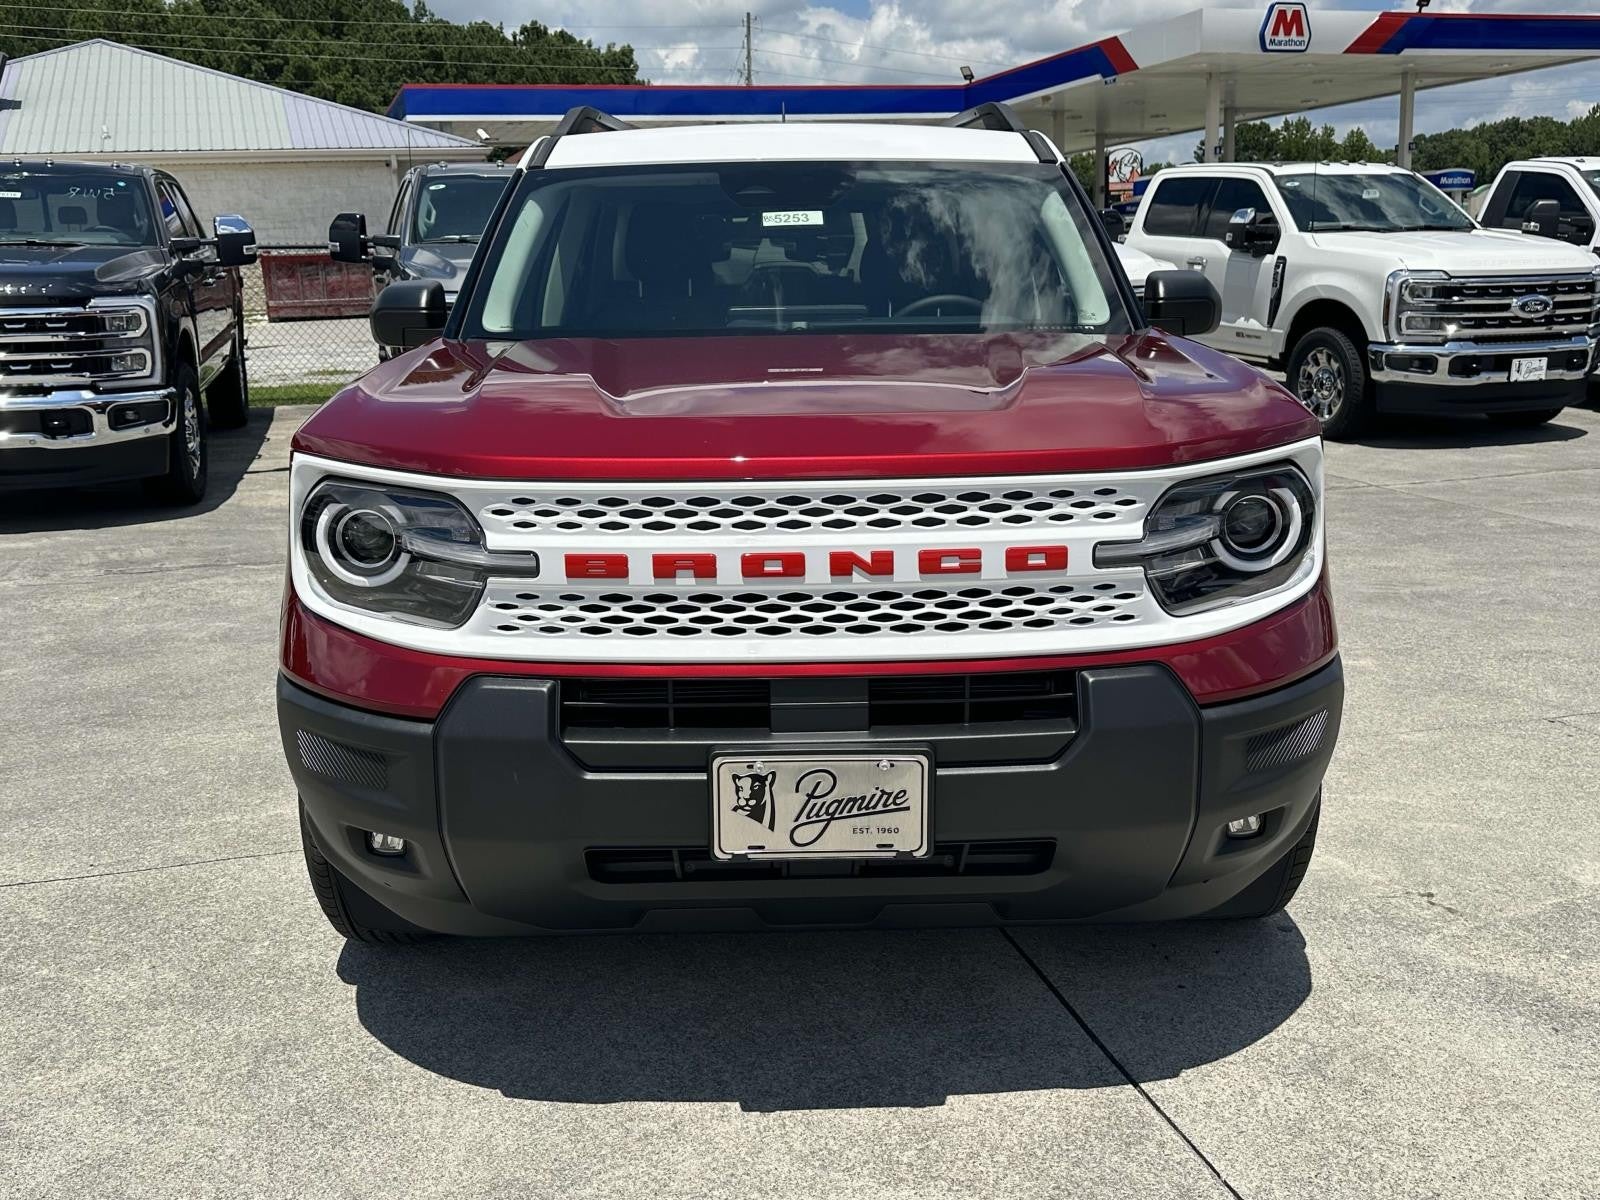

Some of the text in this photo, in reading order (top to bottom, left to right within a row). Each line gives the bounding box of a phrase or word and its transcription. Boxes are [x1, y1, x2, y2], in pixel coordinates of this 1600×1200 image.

[1270, 9, 1305, 37] M
[1268, 38, 1306, 47] Marathon
[1439, 176, 1471, 185] Marathon
[774, 213, 810, 223] 5253
[564, 545, 1070, 579] BRONCO
[789, 768, 911, 848] Pugmire
[852, 826, 900, 835] EST. 1960
